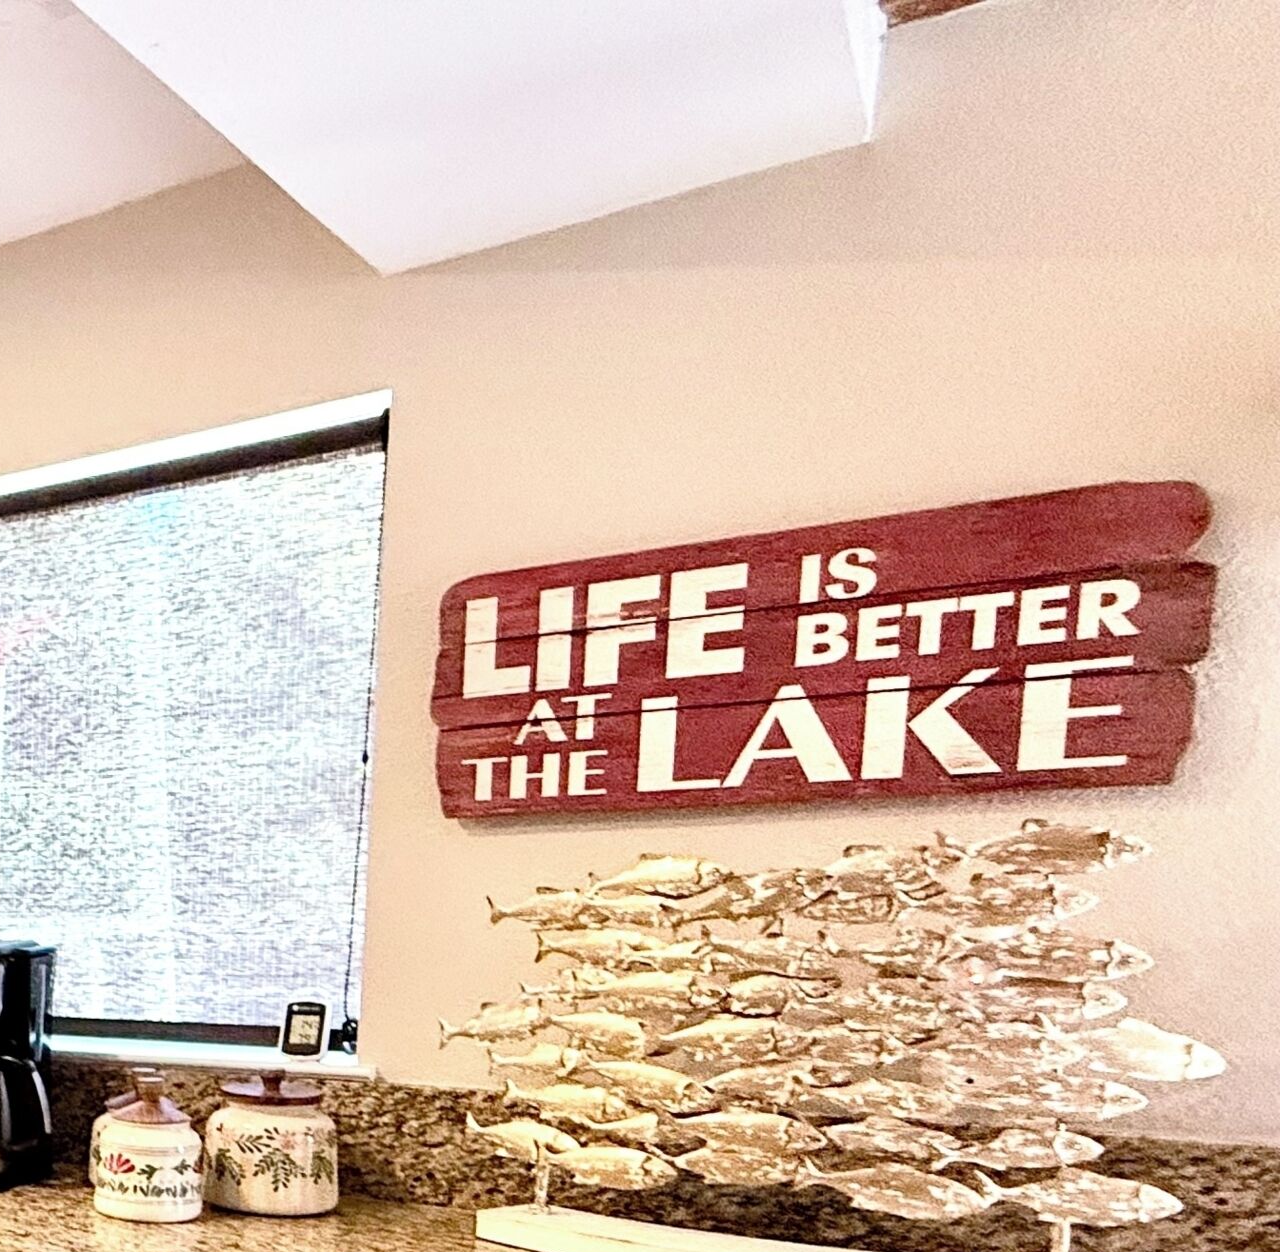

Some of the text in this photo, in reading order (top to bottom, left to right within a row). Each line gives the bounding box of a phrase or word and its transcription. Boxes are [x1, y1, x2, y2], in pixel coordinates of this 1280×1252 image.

[462, 547, 878, 699] LIFE IS
[794, 578, 1142, 668] BETTER
[462, 655, 1135, 802] THE LAKE
[513, 693, 612, 745] AT
